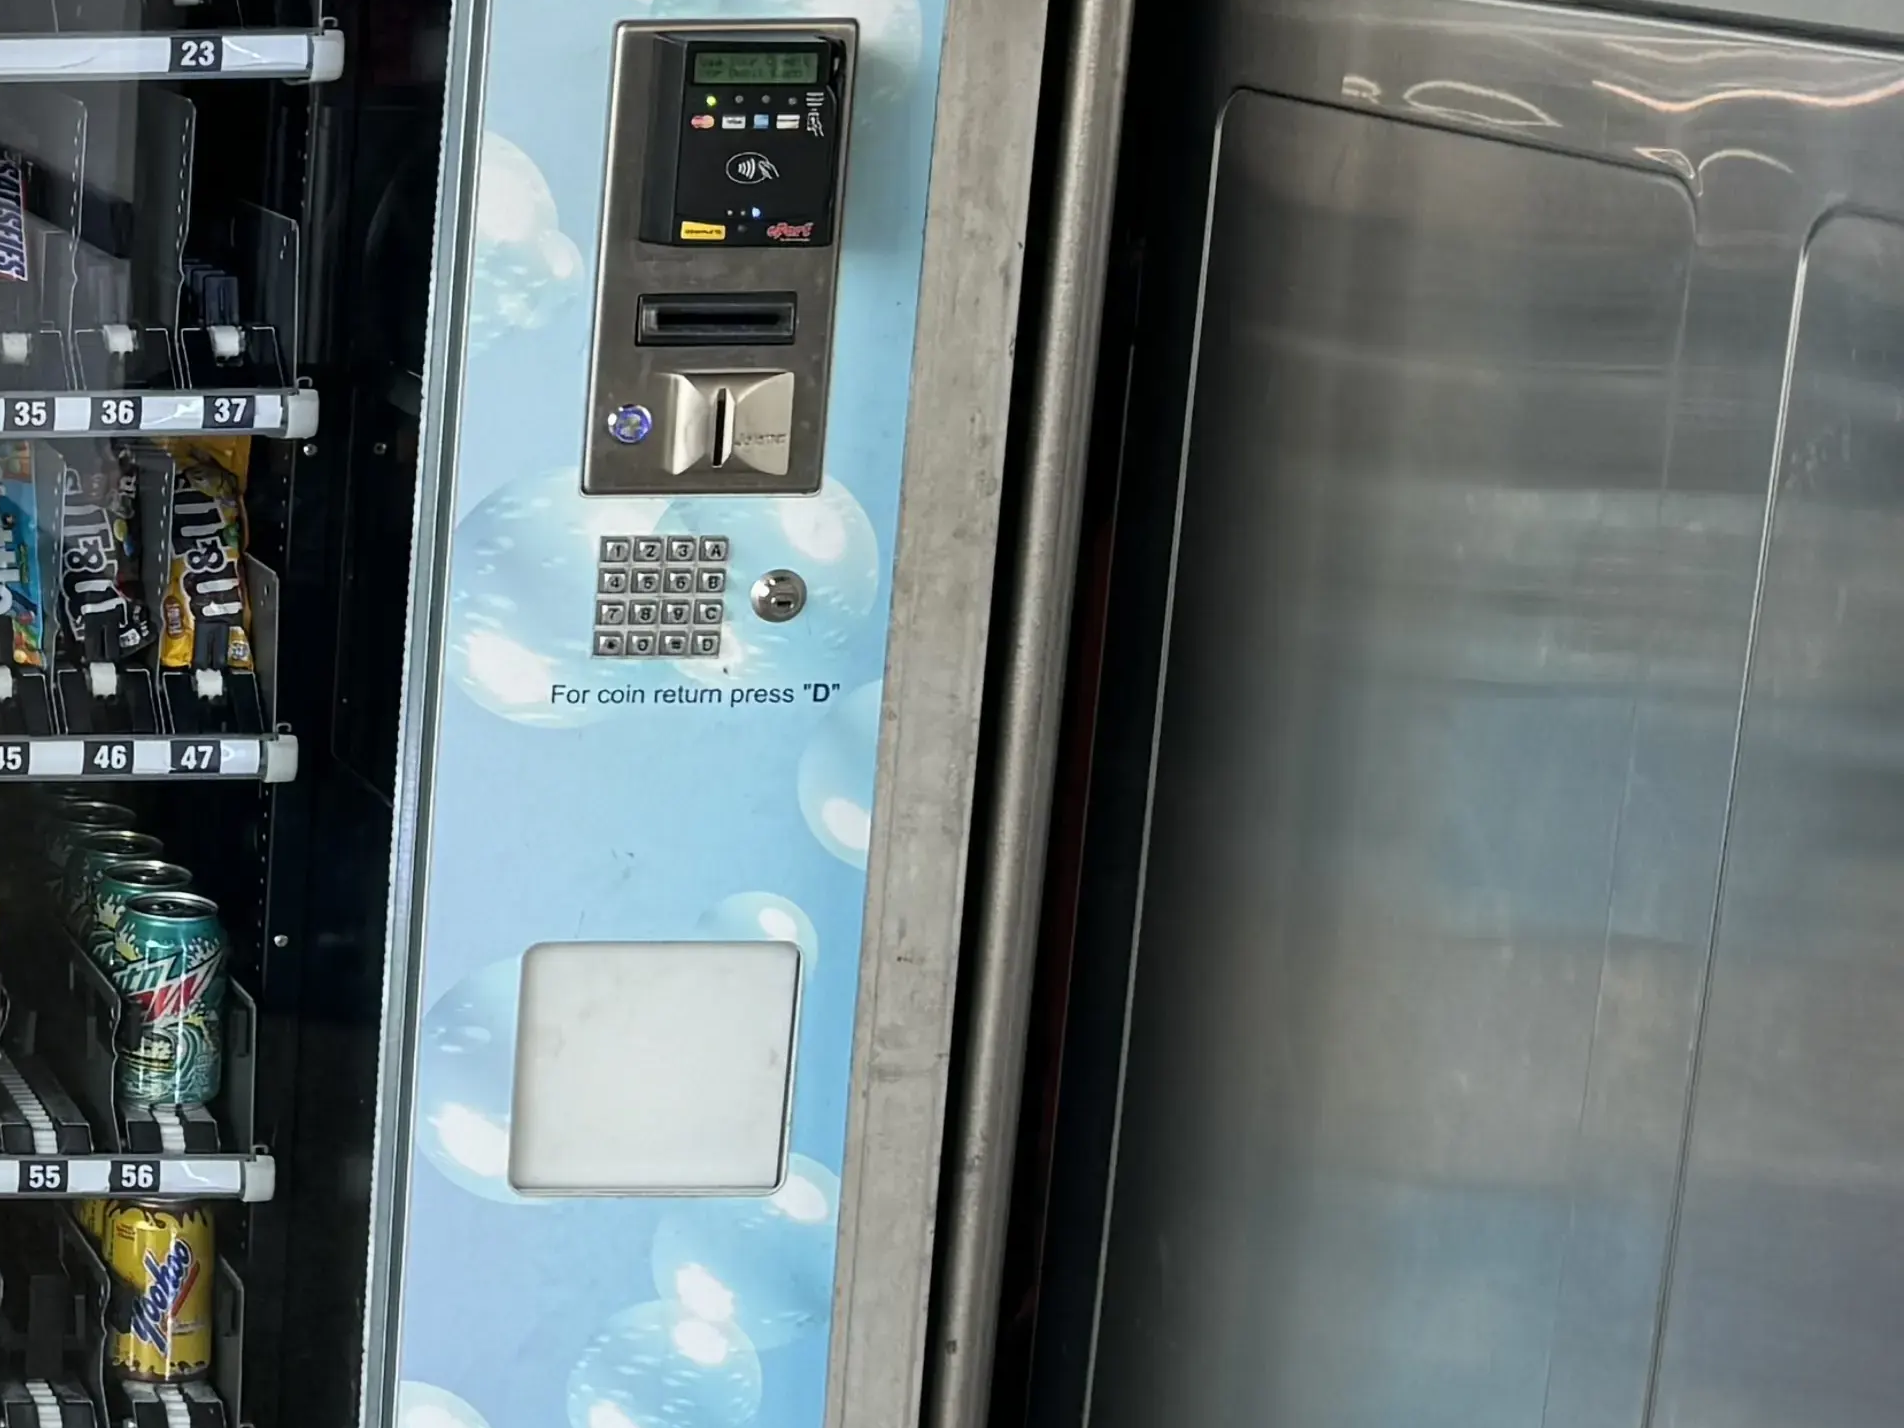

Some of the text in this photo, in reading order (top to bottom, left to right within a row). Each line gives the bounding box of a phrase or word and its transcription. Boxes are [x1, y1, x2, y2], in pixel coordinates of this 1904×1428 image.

[180, 40, 215, 66] 23
[14, 401, 47, 426] 35
[100, 399, 134, 425] 36
[214, 397, 247, 423] 37
[551, 682, 841, 709] For coin return press "D"
[93, 744, 127, 769] 46
[180, 745, 214, 770] 47
[29, 1164, 61, 1189] 55
[121, 1163, 154, 1188] 56
